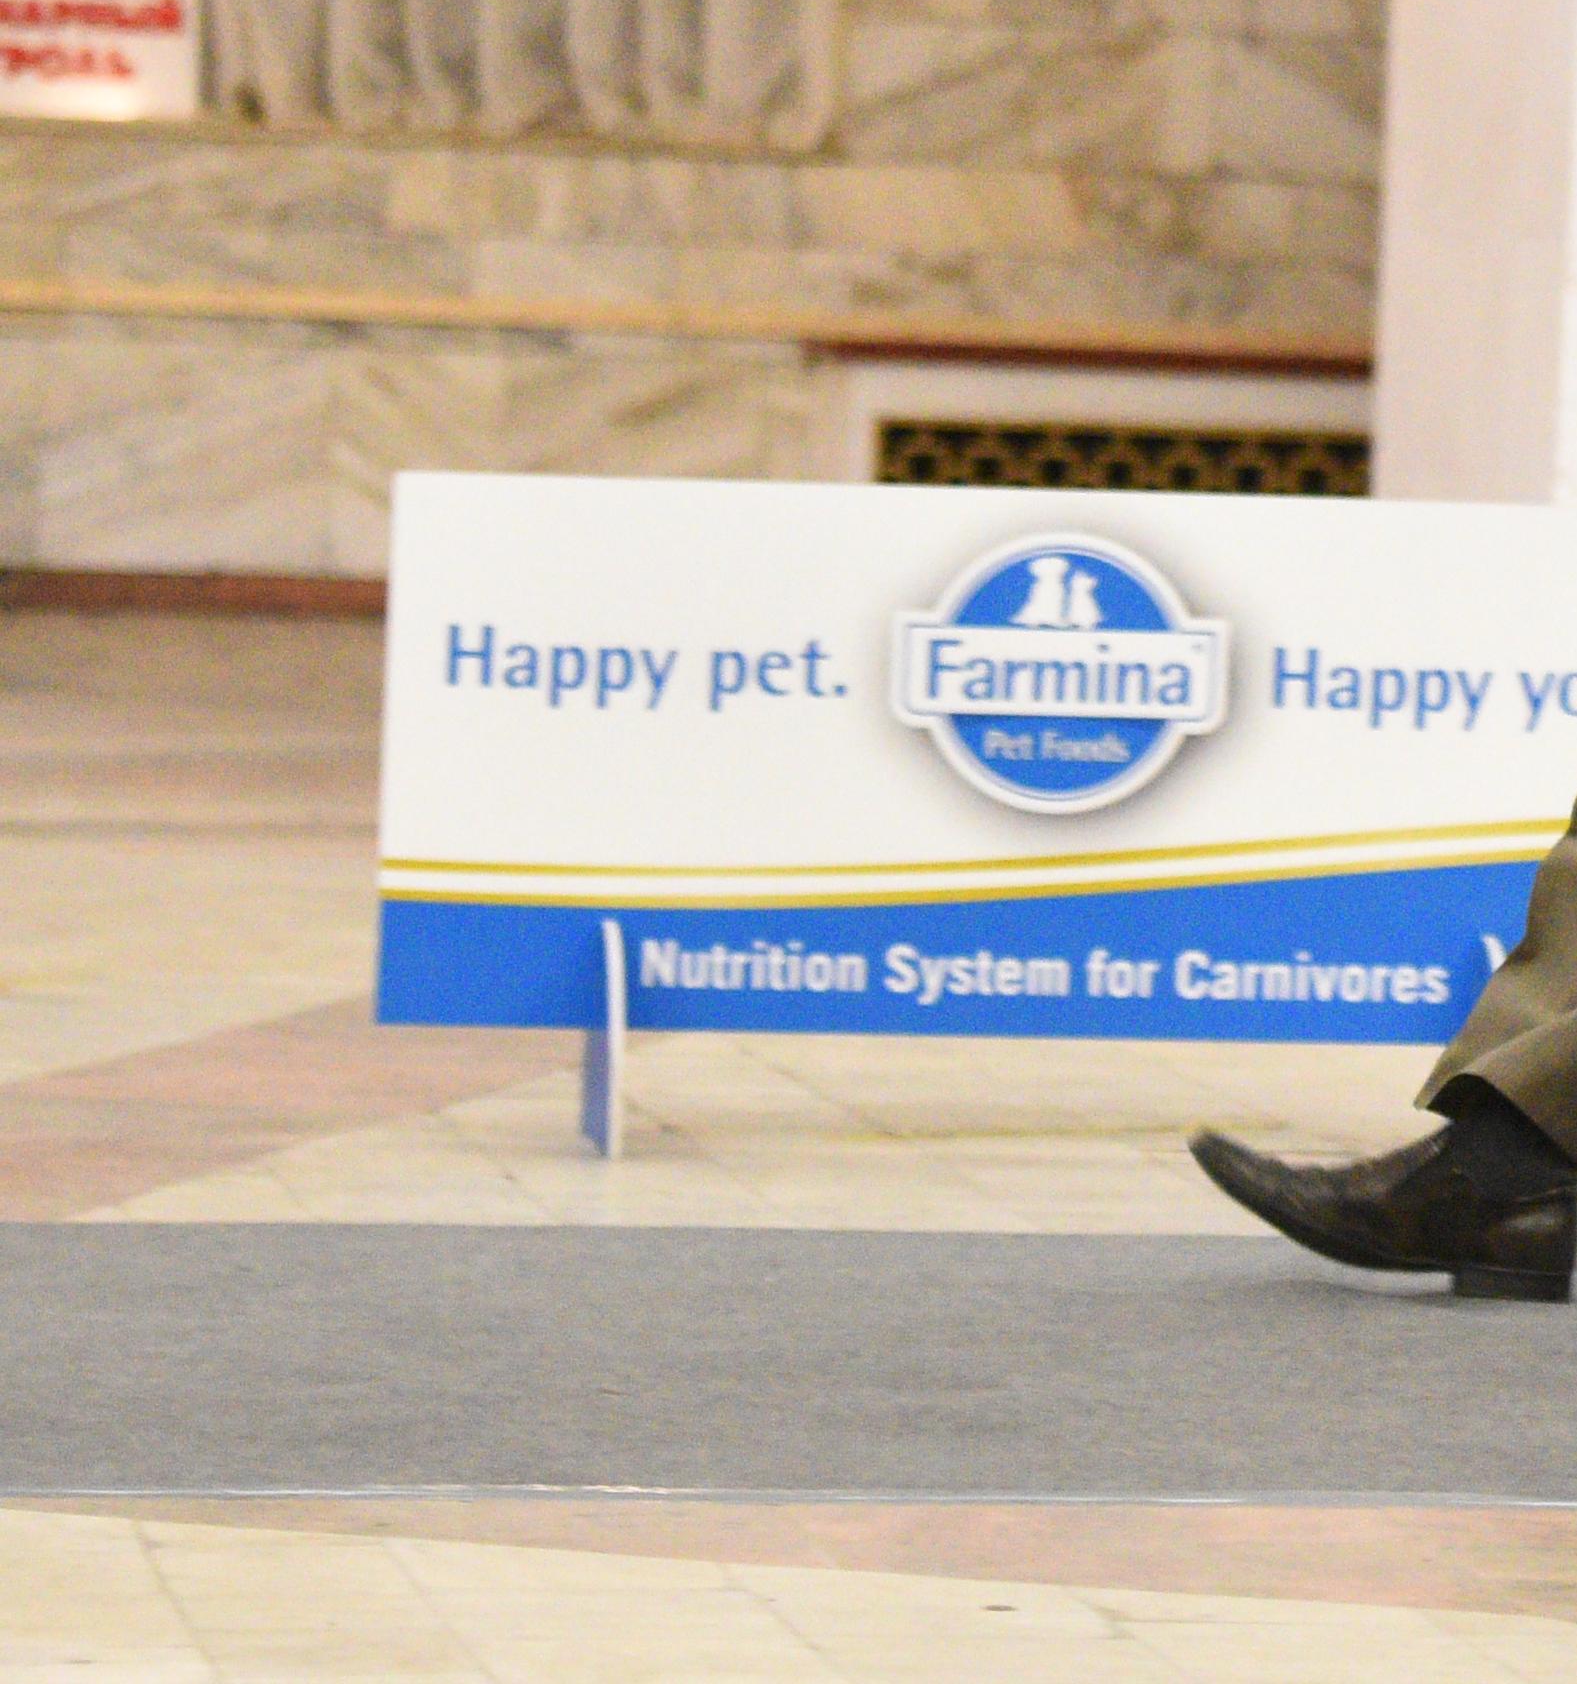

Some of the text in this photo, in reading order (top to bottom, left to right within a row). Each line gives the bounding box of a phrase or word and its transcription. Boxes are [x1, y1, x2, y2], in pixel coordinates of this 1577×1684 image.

[446, 623, 848, 713] Happy pet.
[927, 638, 1192, 707] Farmina
[1272, 647, 1493, 731] Happy
[640, 939, 1451, 1006] Nutrition System for Carnivores
